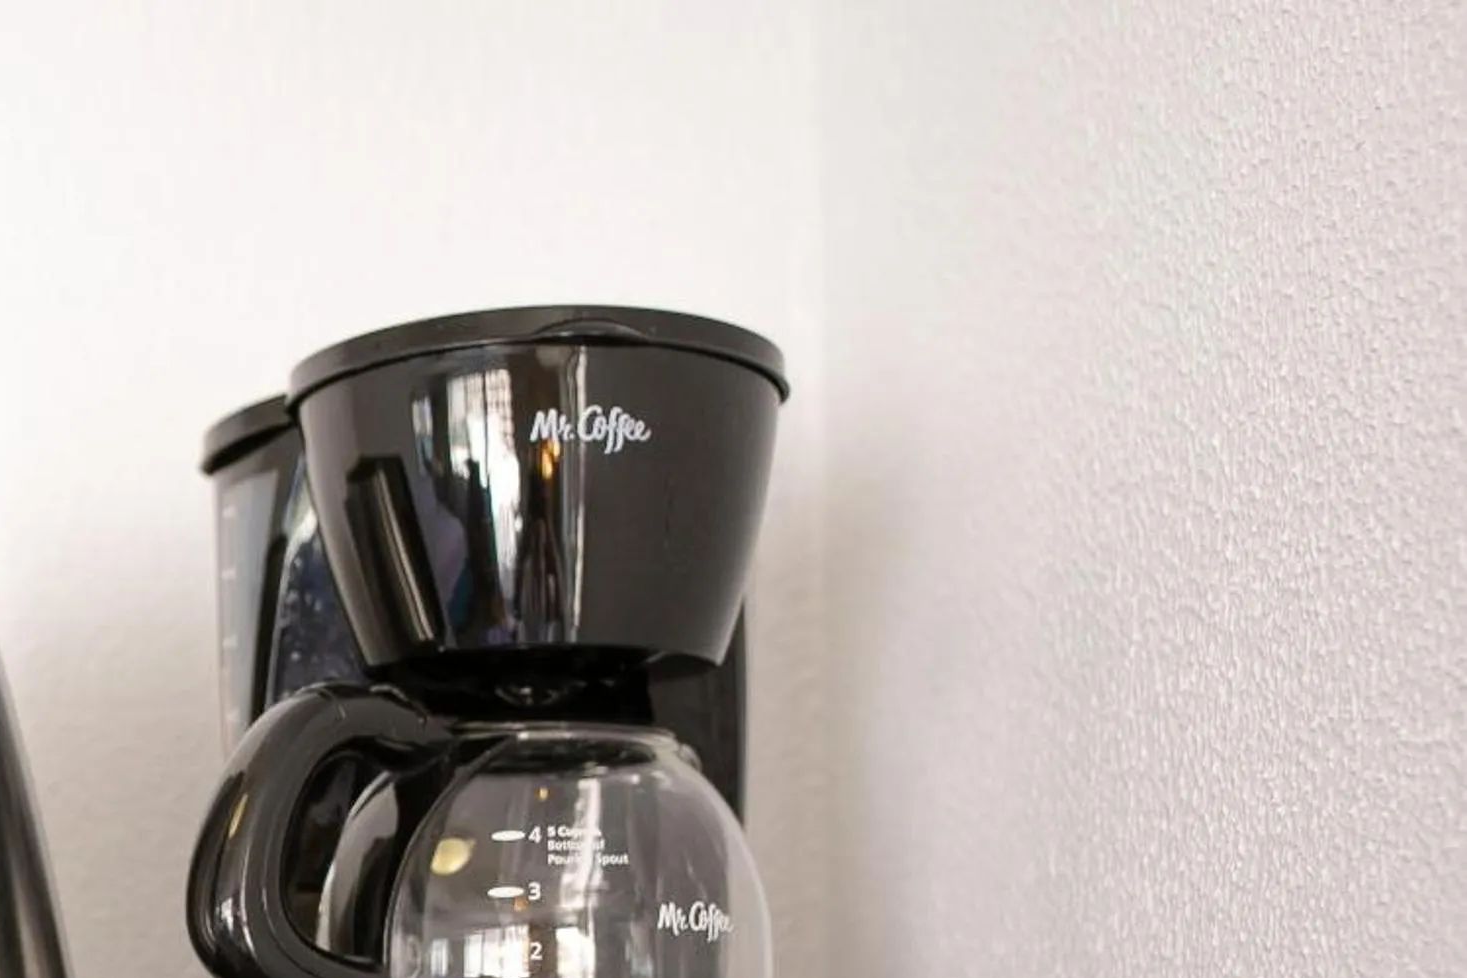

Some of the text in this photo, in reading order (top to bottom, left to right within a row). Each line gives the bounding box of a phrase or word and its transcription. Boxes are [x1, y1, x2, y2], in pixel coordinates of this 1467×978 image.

[530, 404, 652, 458] Mr. Coffee
[528, 825, 542, 843] 4
[528, 881, 542, 901] 3
[657, 901, 733, 943] Mr. Coffee
[530, 941, 543, 961] 2
